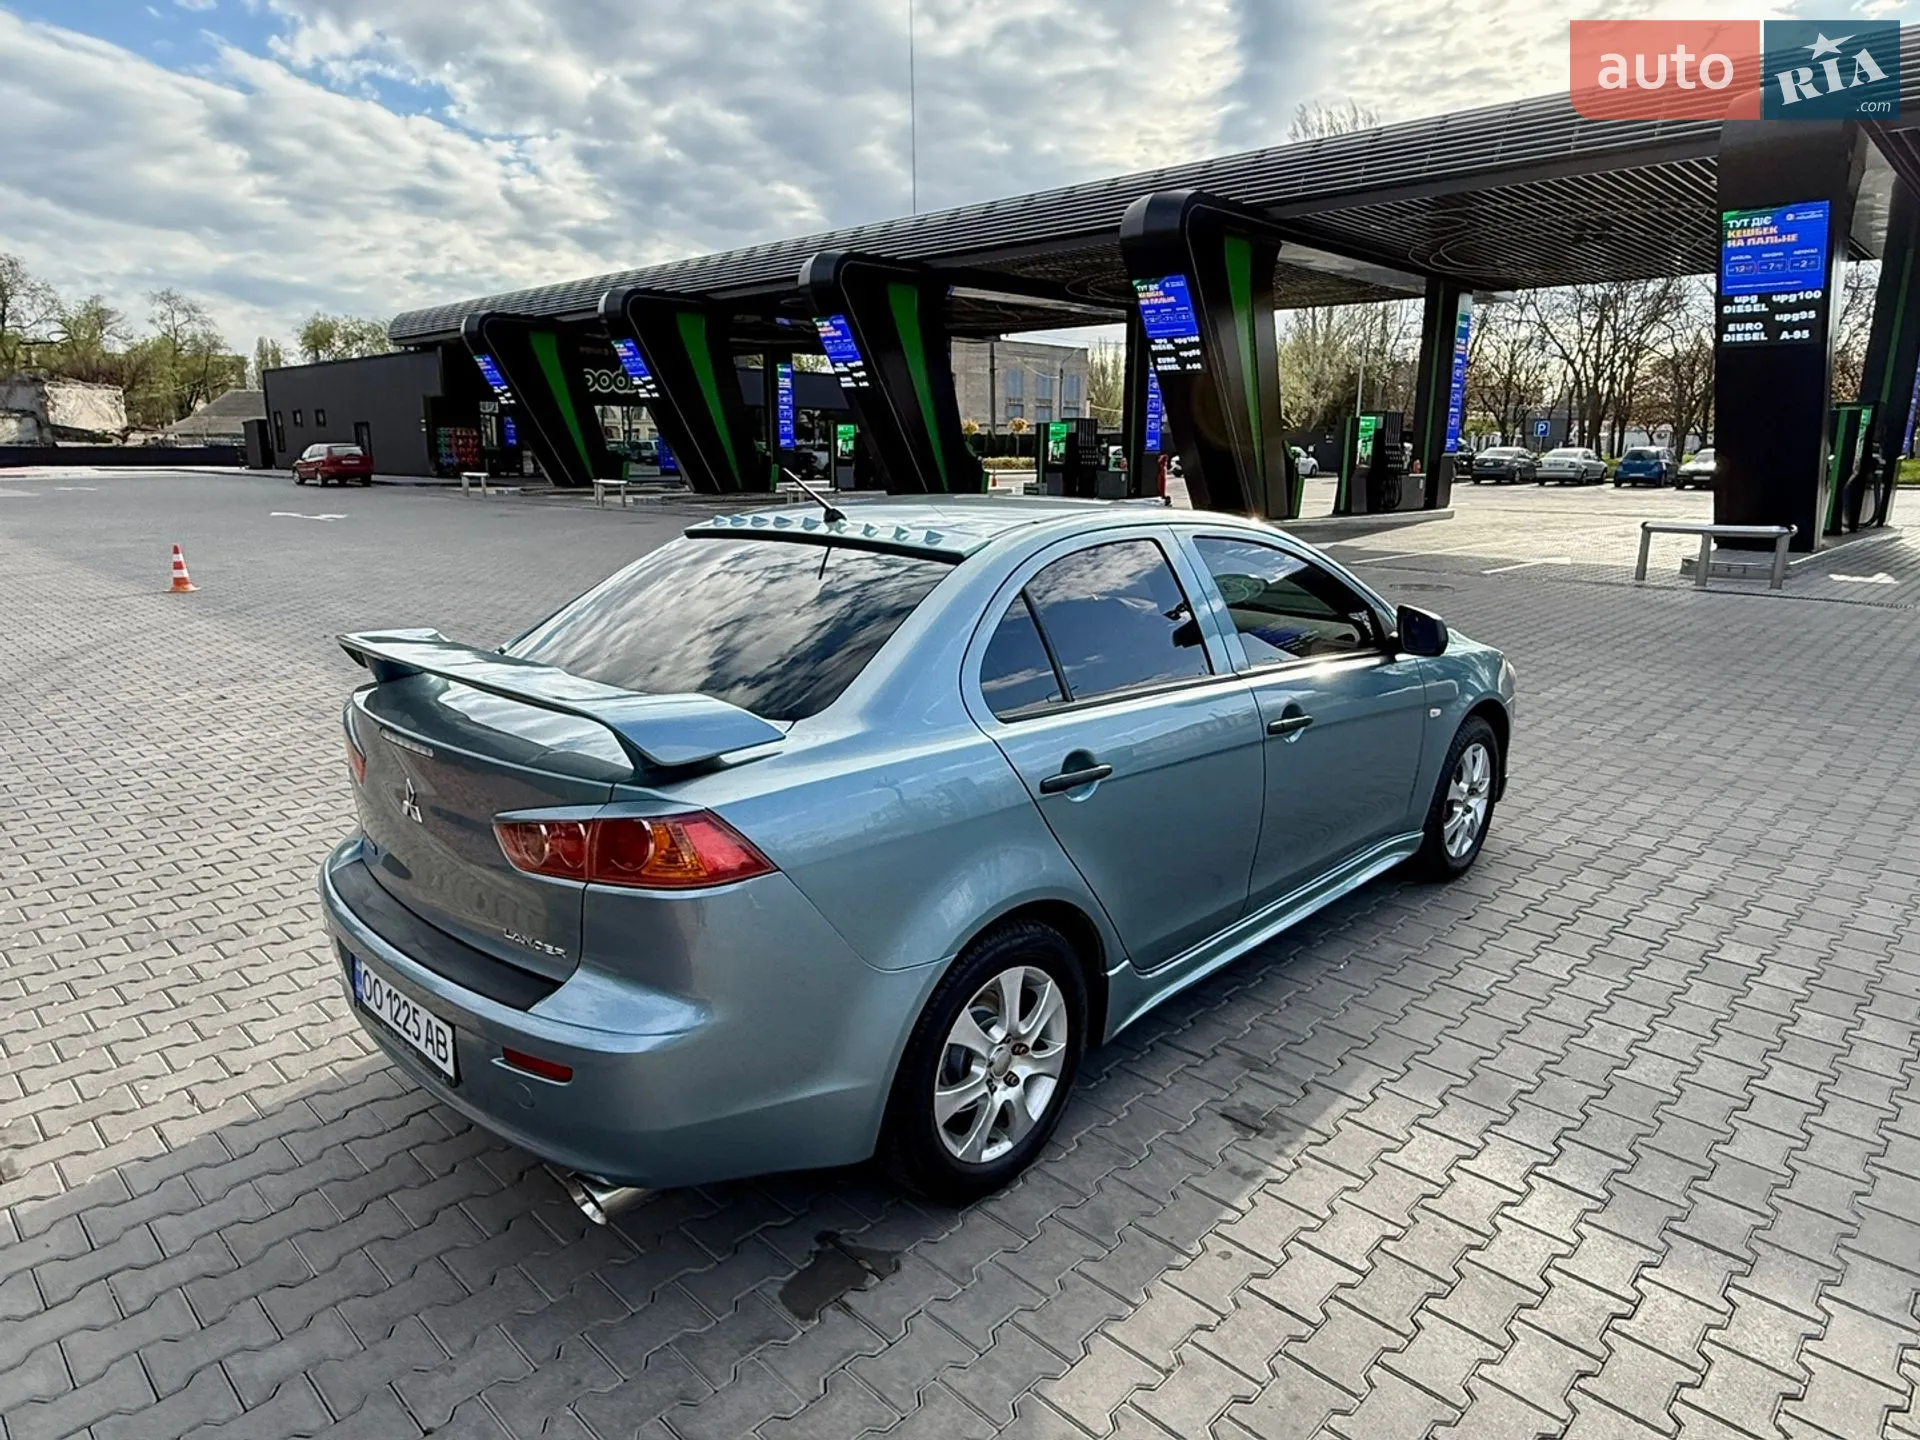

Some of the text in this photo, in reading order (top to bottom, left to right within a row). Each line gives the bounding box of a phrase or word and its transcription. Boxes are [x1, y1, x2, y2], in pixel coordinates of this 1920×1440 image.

[1727, 218, 1750, 228] ТУТ
[1727, 226, 1778, 239] КЕШБЕК
[1727, 233, 1798, 248] НА ПАЛЬНЕ
[1734, 295, 1758, 304] upg
[1772, 290, 1822, 303] upg100
[1723, 303, 1769, 314] DIESEL
[1775, 310, 1816, 322] upg95
[1728, 322, 1764, 332] EURO
[1722, 331, 1768, 342] DIESEL
[1779, 329, 1810, 340] A-95
[502, 928, 567, 959] LANCER
[363, 969, 384, 1011] OO
[386, 988, 421, 1042] 1225
[425, 1018, 448, 1064] AB
